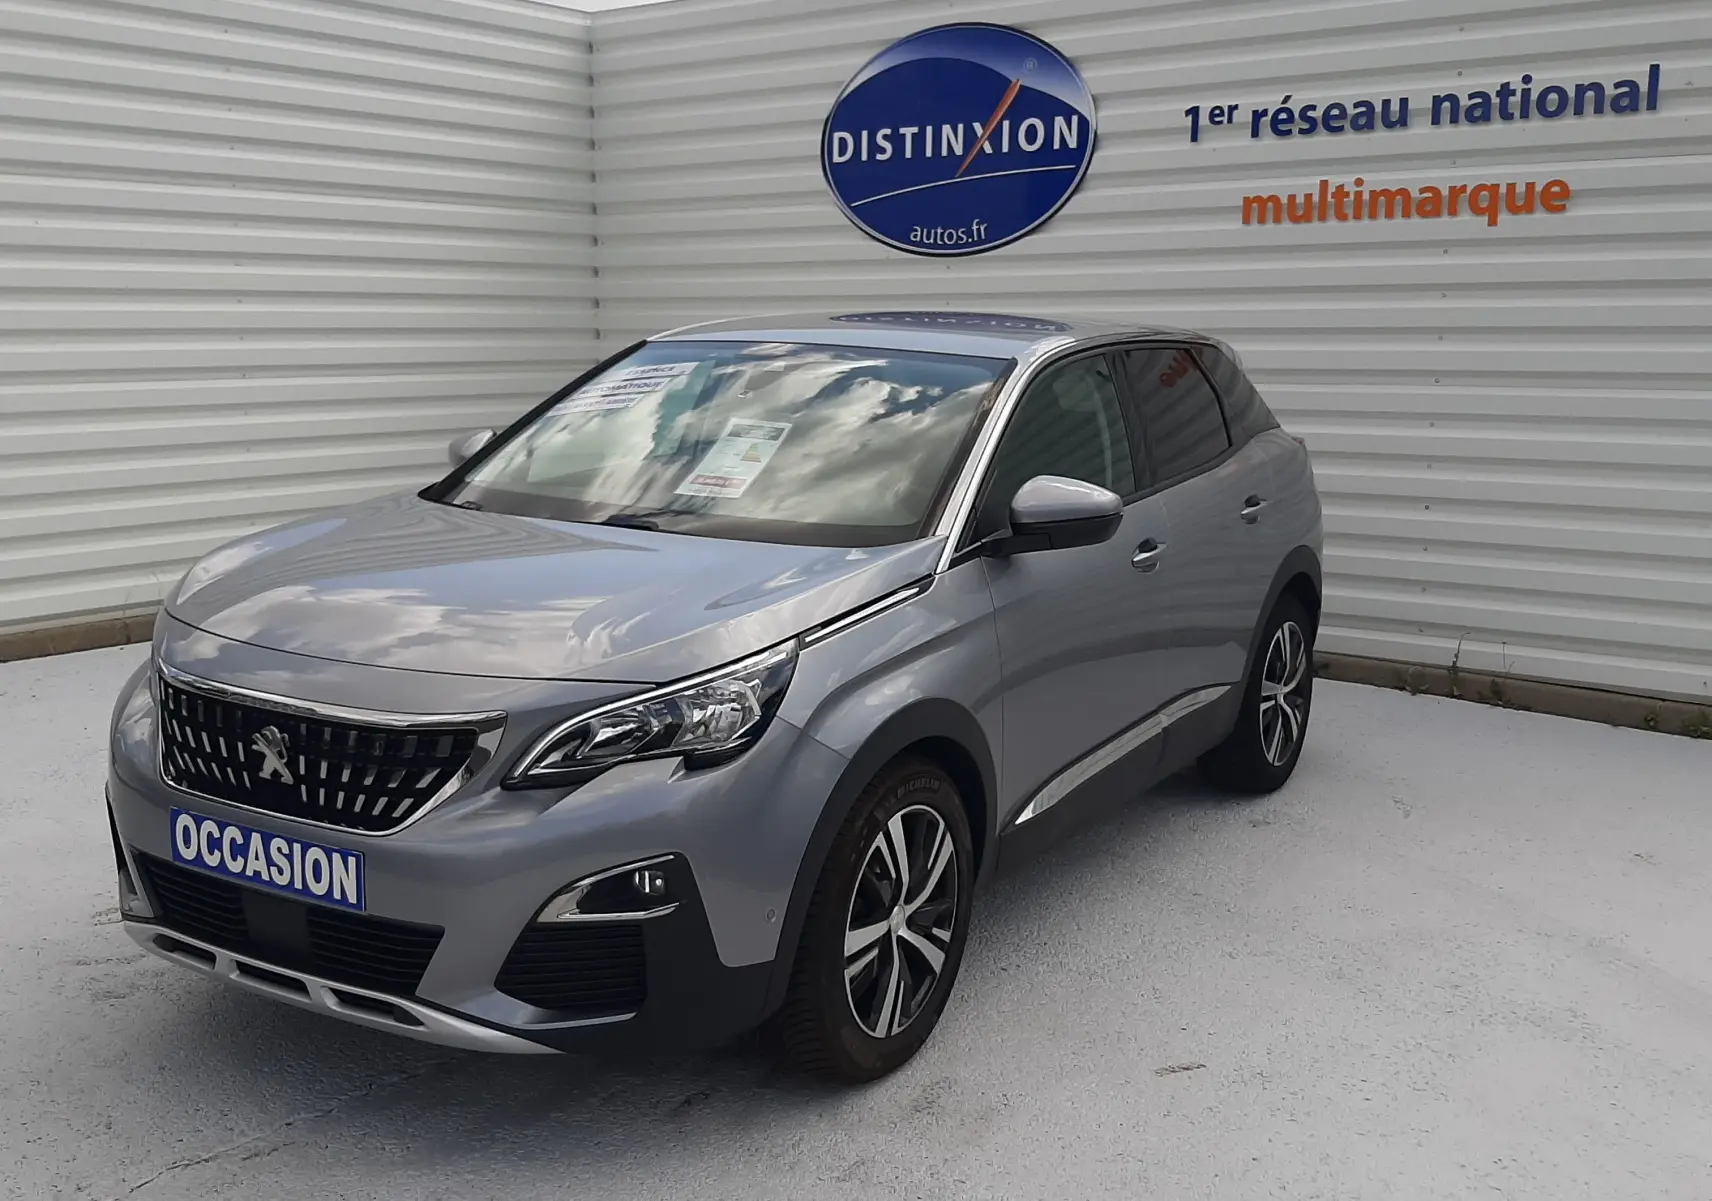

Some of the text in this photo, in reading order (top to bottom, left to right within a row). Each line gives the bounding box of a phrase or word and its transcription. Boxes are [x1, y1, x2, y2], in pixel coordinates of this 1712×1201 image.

[1184, 63, 1661, 143] 1er réseau national
[831, 111, 1079, 167] DISTINXION
[1241, 177, 1571, 227] multimarque
[909, 219, 988, 245] autos.fr
[175, 813, 357, 905] OCCASION
